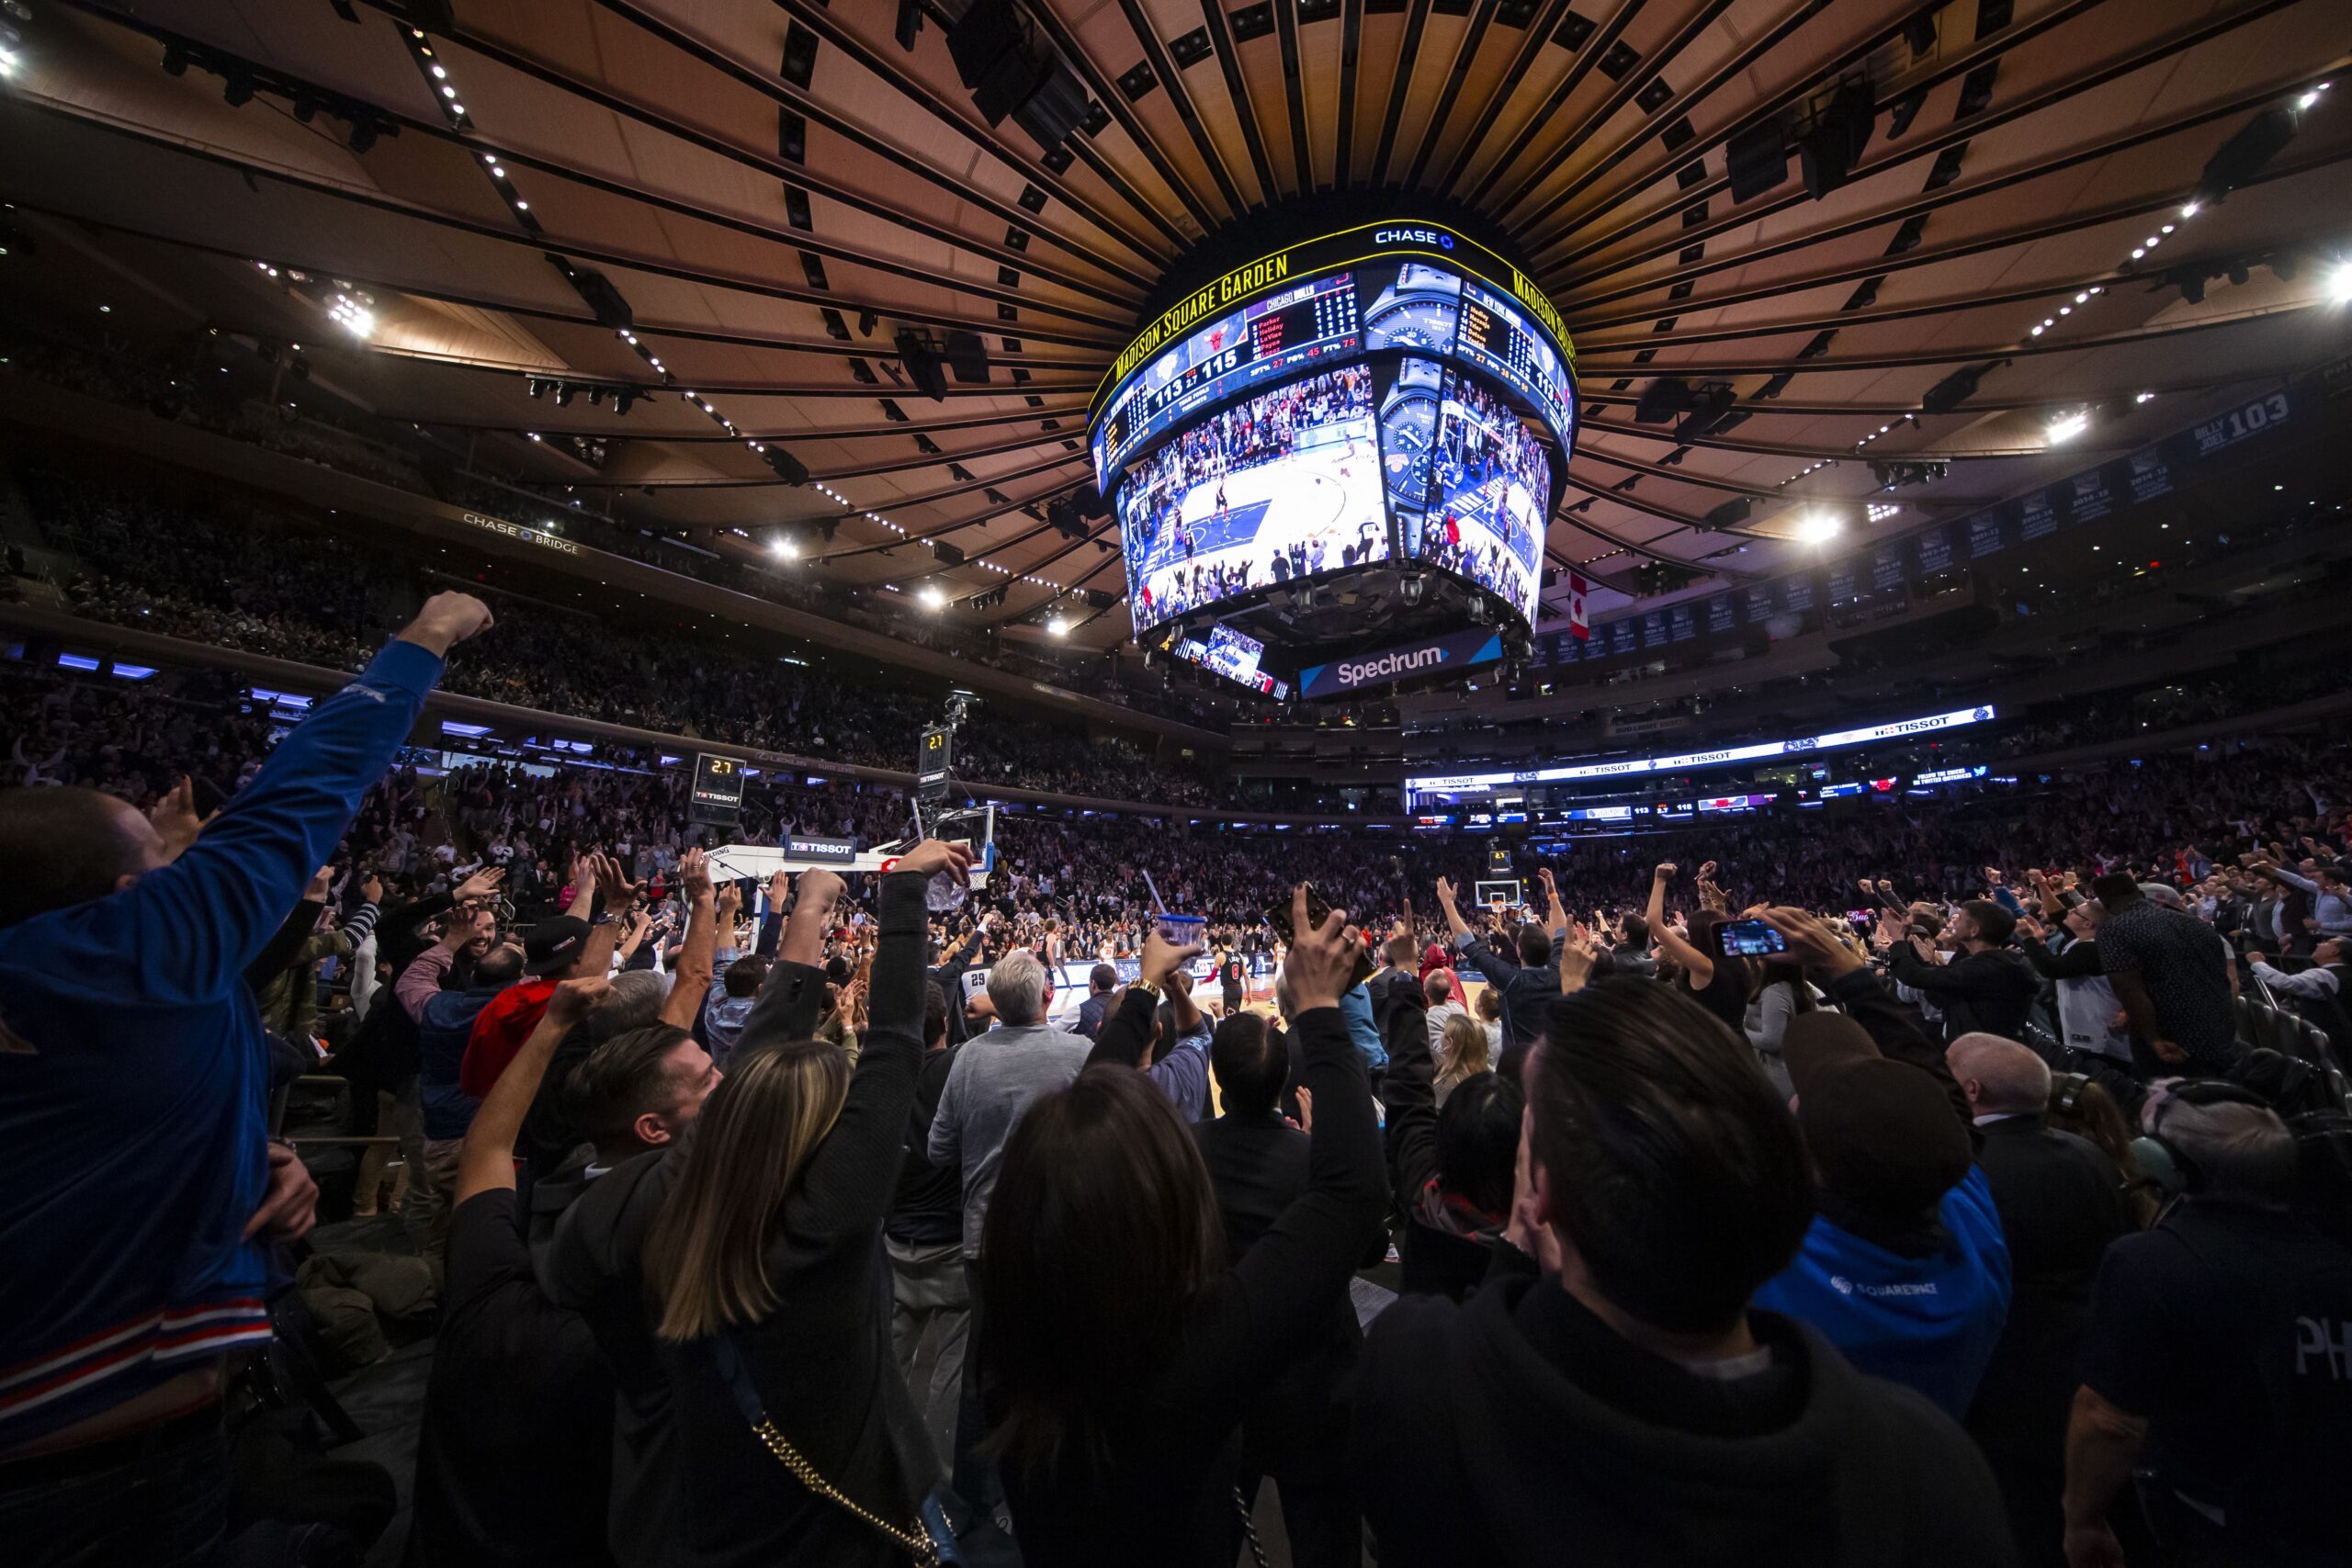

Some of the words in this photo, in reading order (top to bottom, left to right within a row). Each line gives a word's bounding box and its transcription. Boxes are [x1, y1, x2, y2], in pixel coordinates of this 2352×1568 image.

[1375, 231, 1437, 244] CHASE
[1266, 292, 1293, 310] CHICAGO
[1293, 284, 1315, 300] BULLS
[1512, 269, 1555, 332] MADISON
[1116, 323, 1159, 383] MADISON
[1164, 287, 1216, 337] SQUARE
[1221, 254, 1287, 302] GARDEN
[1259, 316, 1281, 329] Parker
[1259, 323, 1283, 336] Holiday
[1260, 332, 1283, 344] LaVine
[1261, 340, 1281, 352] Payne
[1250, 364, 1271, 377] 3PT%
[1272, 358, 1284, 368] 27
[1286, 352, 1305, 364] FG%
[1307, 347, 1319, 357] 45
[1323, 343, 1340, 353] FT%
[1342, 338, 1355, 348] 75
[1476, 353, 1486, 363] 27
[1155, 378, 1182, 408] 113
[1186, 375, 1198, 389] 2.7
[1202, 349, 1237, 378] 115
[1186, 368, 1196, 378] OT2
[1536, 372, 1554, 401] 113
[2229, 393, 2289, 437] 103
[2194, 418, 2224, 440] BILLY
[2199, 432, 2228, 450] JOEL
[2130, 466, 2168, 486] 2014-15
[2072, 488, 2109, 507] 2014-15
[463, 513, 516, 536] CHASE
[536, 535, 579, 555] BRIDGE
[1338, 647, 1442, 686] Spectrum
[1895, 716, 1950, 733] TISSOT
[929, 735, 942, 750] 2.7
[1690, 751, 1731, 764] TISSOT
[711, 760, 731, 774] 2.7
[1596, 763, 1632, 773] TISSOT
[927, 772, 945, 782] TISSOT
[708, 793, 740, 802] TISSOT
[1677, 803, 1692, 811] 115
[808, 843, 852, 855] TISSOT
[971, 972, 986, 987] 29
